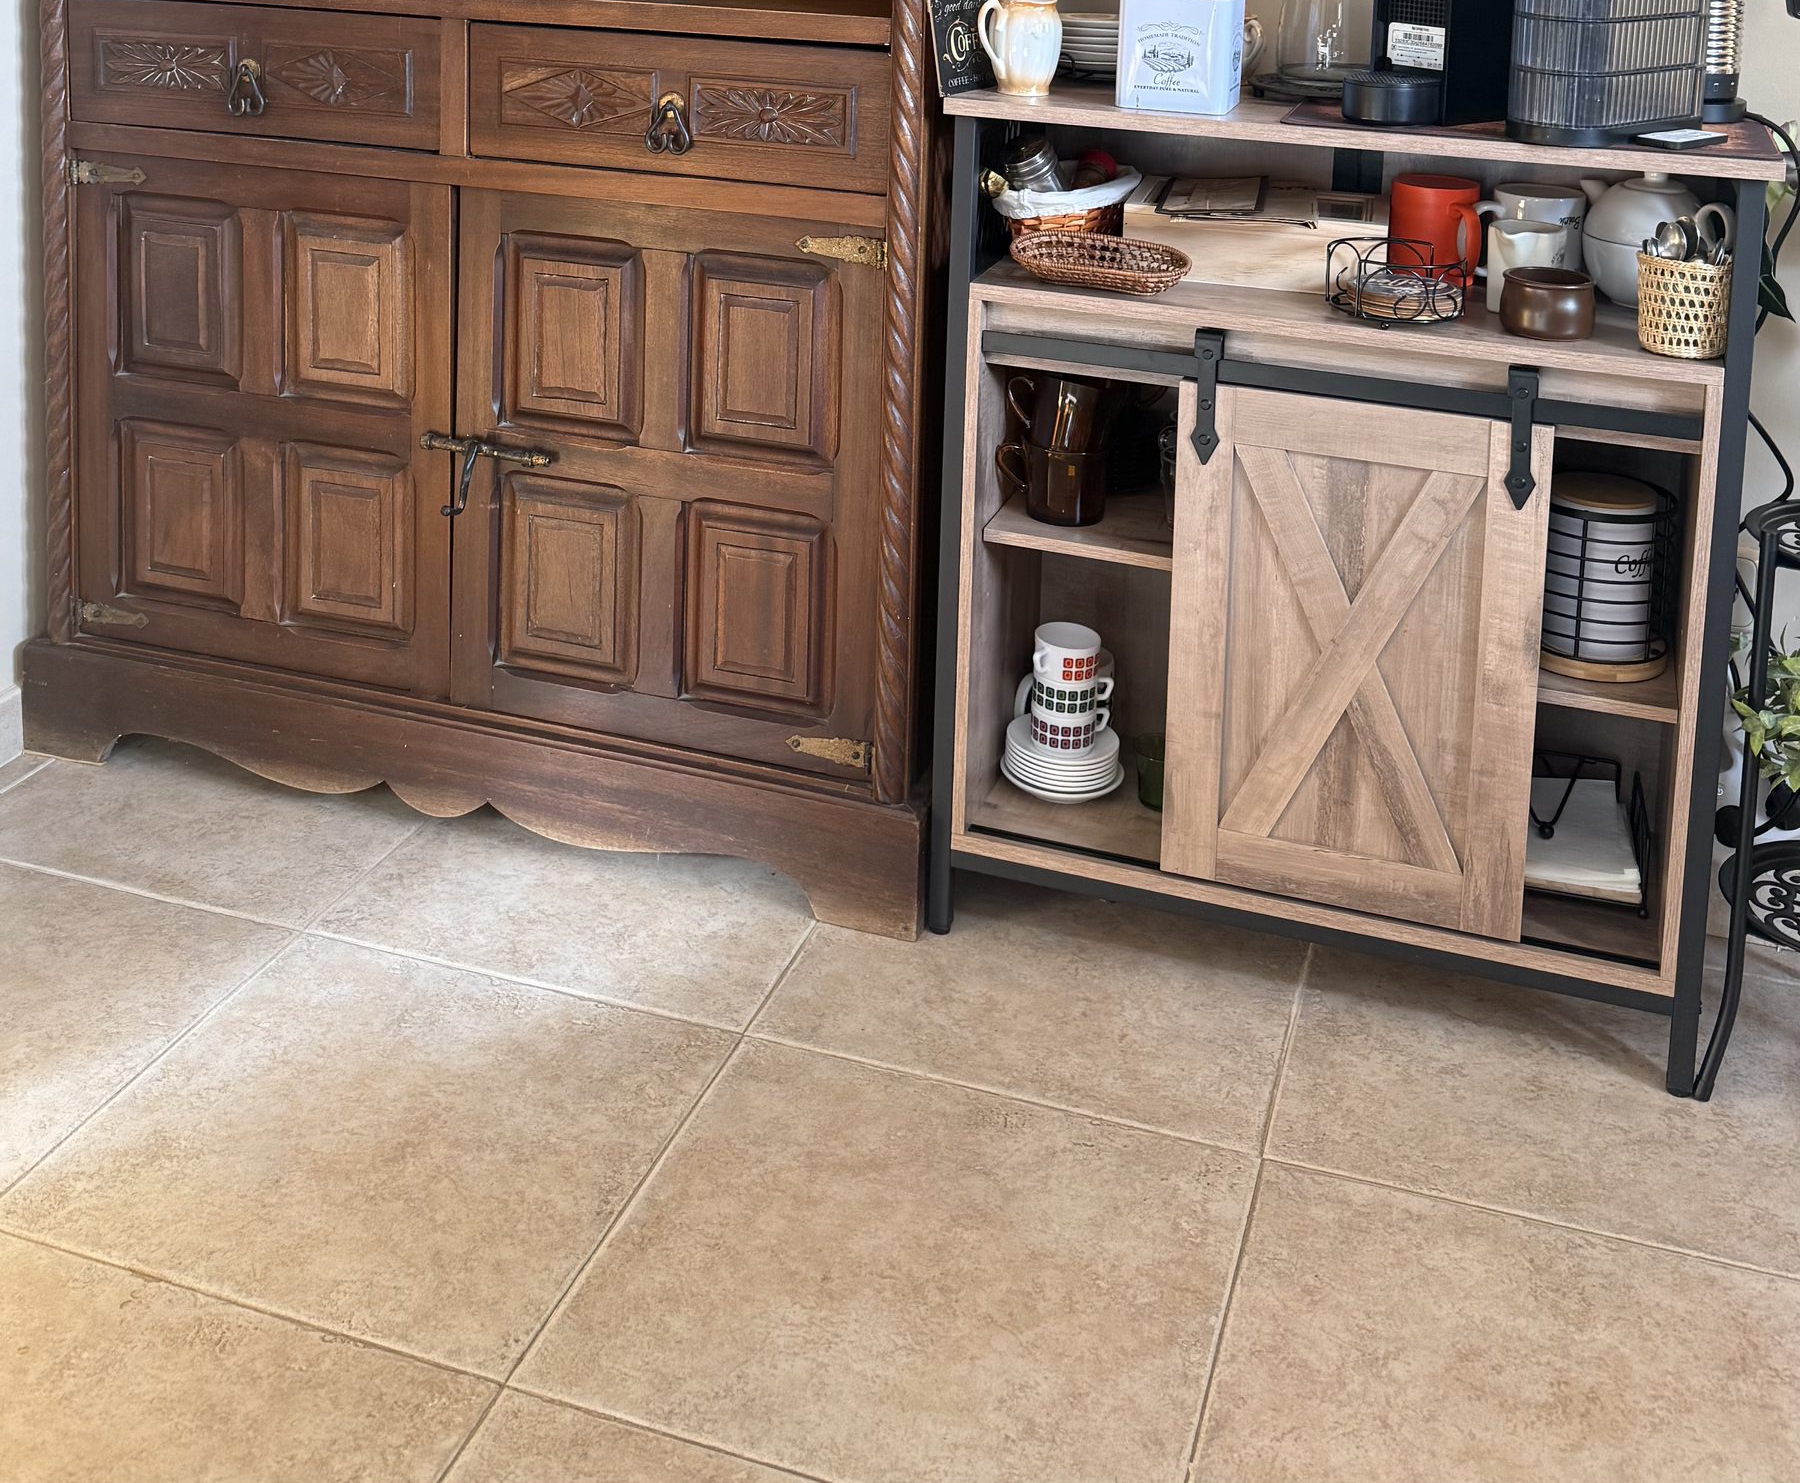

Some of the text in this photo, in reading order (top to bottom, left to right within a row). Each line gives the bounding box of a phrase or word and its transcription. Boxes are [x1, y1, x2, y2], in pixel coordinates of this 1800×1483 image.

[944, 0, 962, 17] good
[950, 26, 983, 62] COFF
[1137, 32, 1201, 47] HOMEMADE TRADITION
[948, 76, 969, 88] COFFEE
[1153, 72, 1181, 89] Coffee
[1615, 548, 1651, 578] Coff
